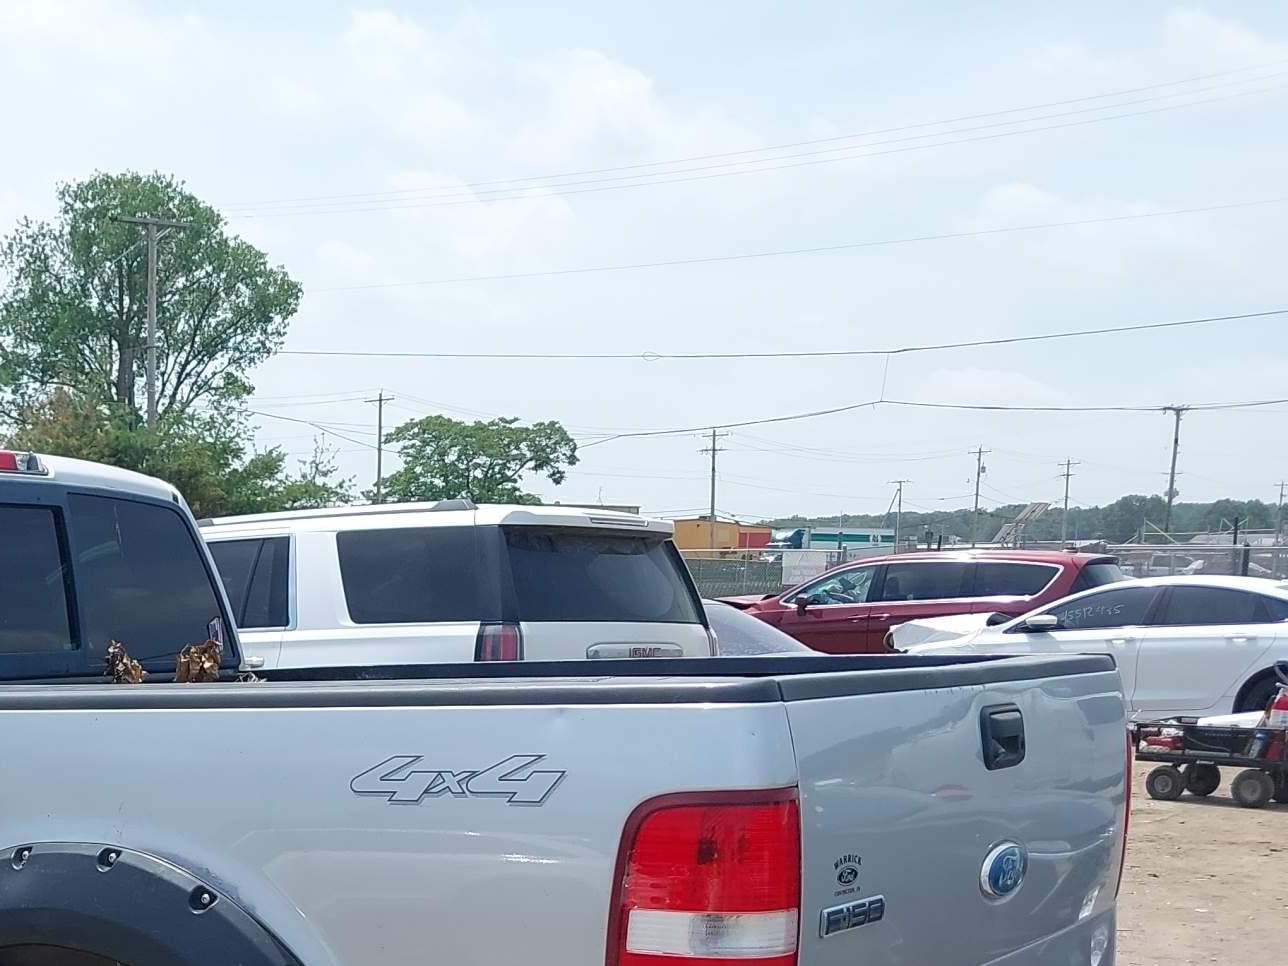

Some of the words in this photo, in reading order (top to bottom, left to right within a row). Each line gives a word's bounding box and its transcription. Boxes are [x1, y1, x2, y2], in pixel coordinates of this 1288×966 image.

[631, 647, 662, 657] GMC
[349, 754, 567, 807] 4x4
[833, 854, 862, 870] WARRICK
[992, 847, 1024, 892] Ford
[839, 867, 857, 883] Ford
